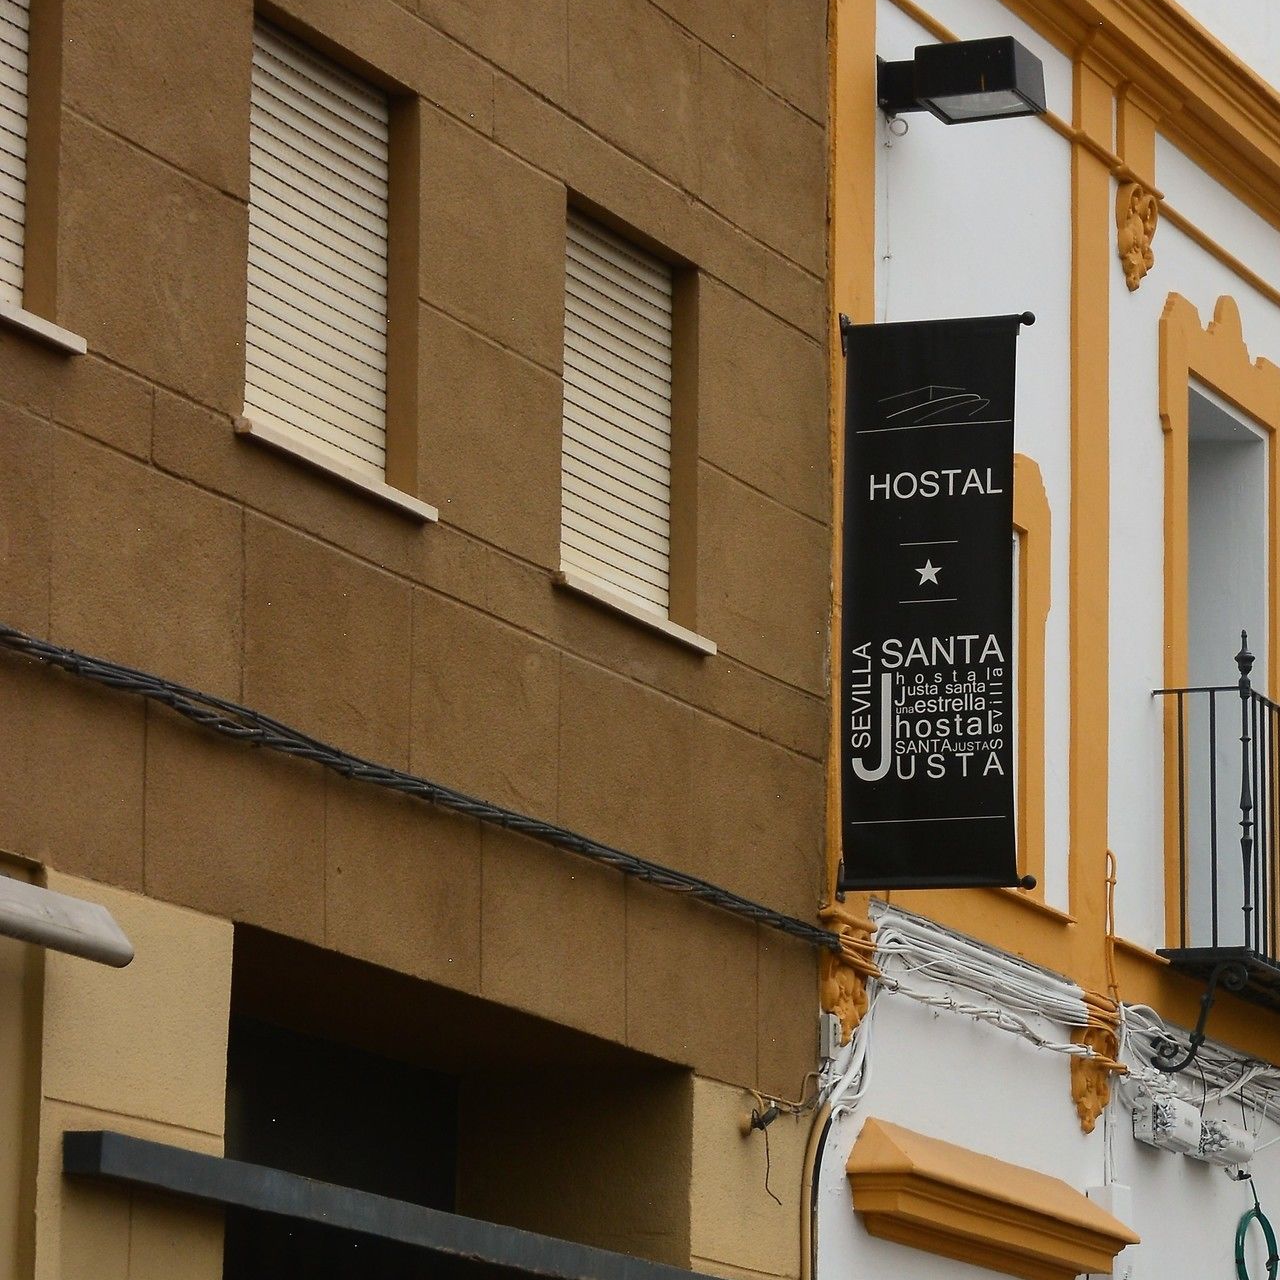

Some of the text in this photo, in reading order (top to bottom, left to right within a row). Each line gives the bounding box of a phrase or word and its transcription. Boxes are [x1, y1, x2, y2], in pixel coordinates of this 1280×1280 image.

[869, 467, 1003, 501] HOSTAL
[880, 633, 1005, 669] SANTA
[851, 641, 872, 749] SEVILLA
[945, 680, 986, 695] santa
[895, 693, 986, 715] una estrella
[895, 709, 993, 739] hostal
[895, 738, 991, 755] SANTA JUSTA
